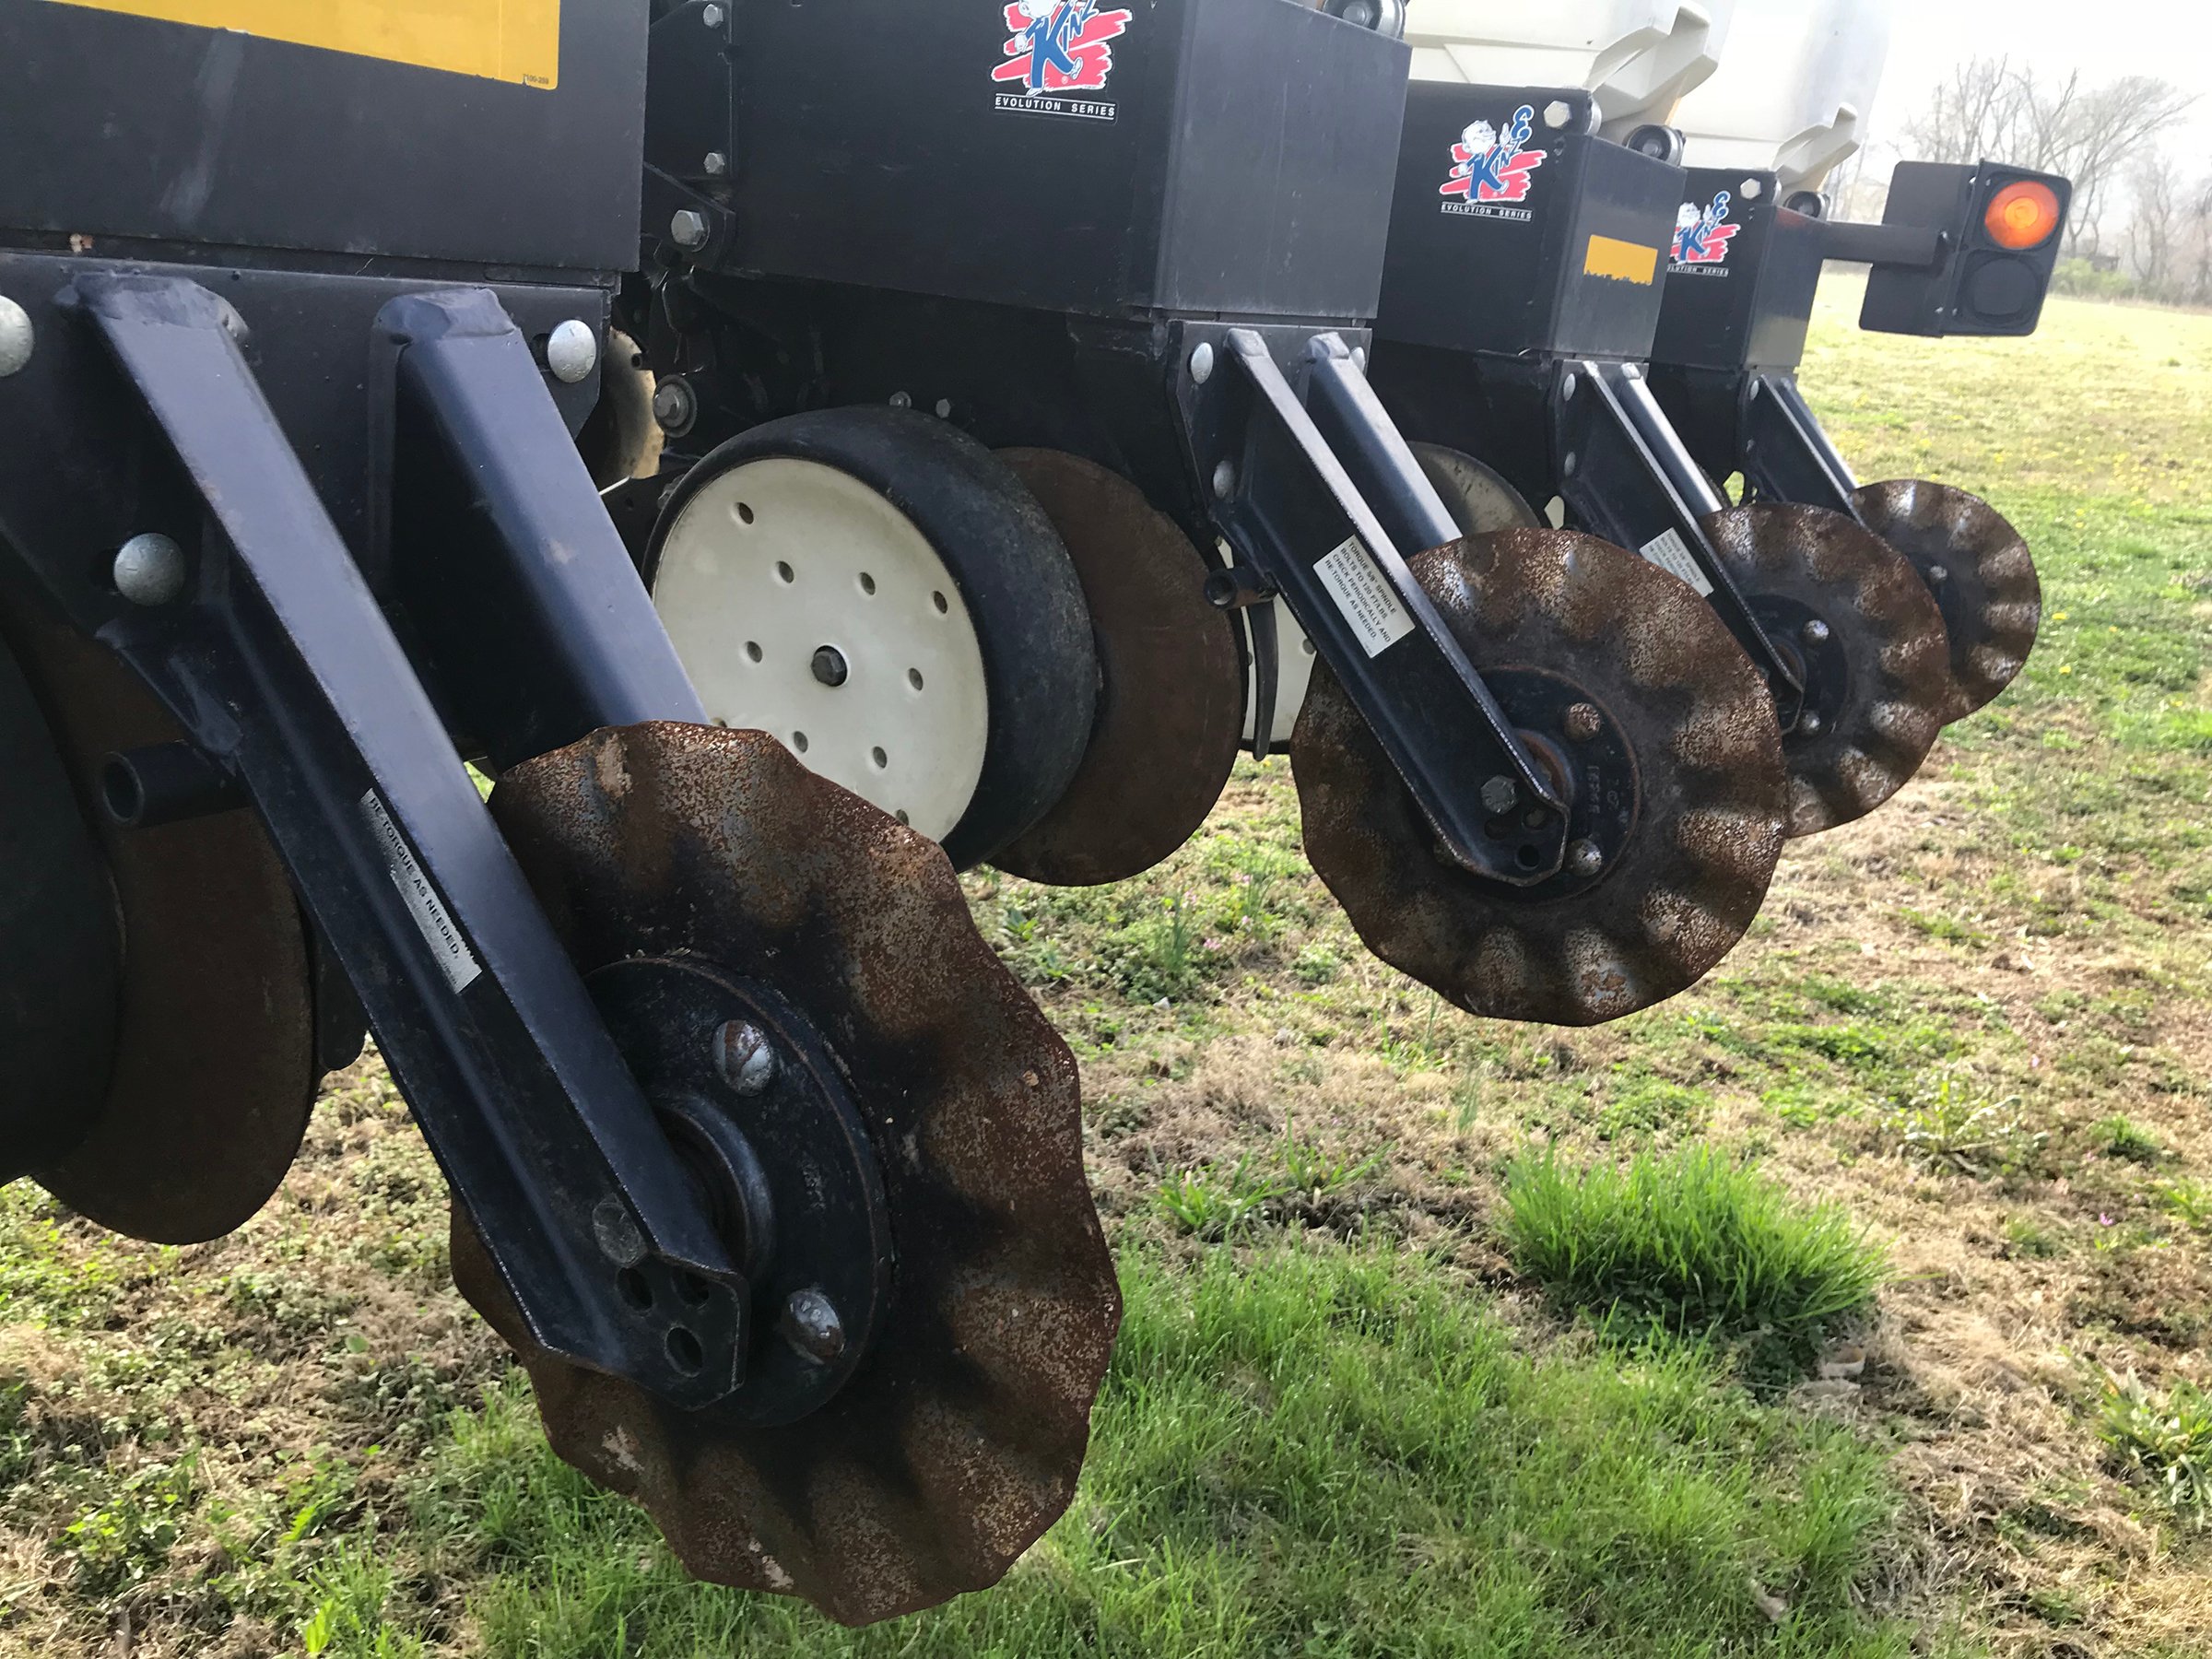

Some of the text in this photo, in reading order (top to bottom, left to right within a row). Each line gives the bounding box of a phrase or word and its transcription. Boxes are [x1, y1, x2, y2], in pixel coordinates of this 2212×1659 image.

[994, 96, 1115, 117] EVOLUTION SERIES
[1441, 203, 1532, 219] EVOLUTION SERIES
[1324, 559, 1351, 600] RE-TORQUE
[1349, 600, 1359, 610] AS
[1357, 609, 1377, 641] NEEDED.
[1332, 554, 1349, 578] CHECK
[1347, 578, 1382, 627] PERIODICALLY
[1379, 628, 1392, 642] AND
[1340, 547, 1358, 571] BOLTS
[1356, 571, 1364, 582] TO
[1363, 582, 1372, 595] 120
[1348, 542, 1371, 571] TORQUE
[1375, 584, 1396, 615] SPINDLE
[413, 878, 427, 898] AS
[425, 899, 460, 959] NEEDED.
